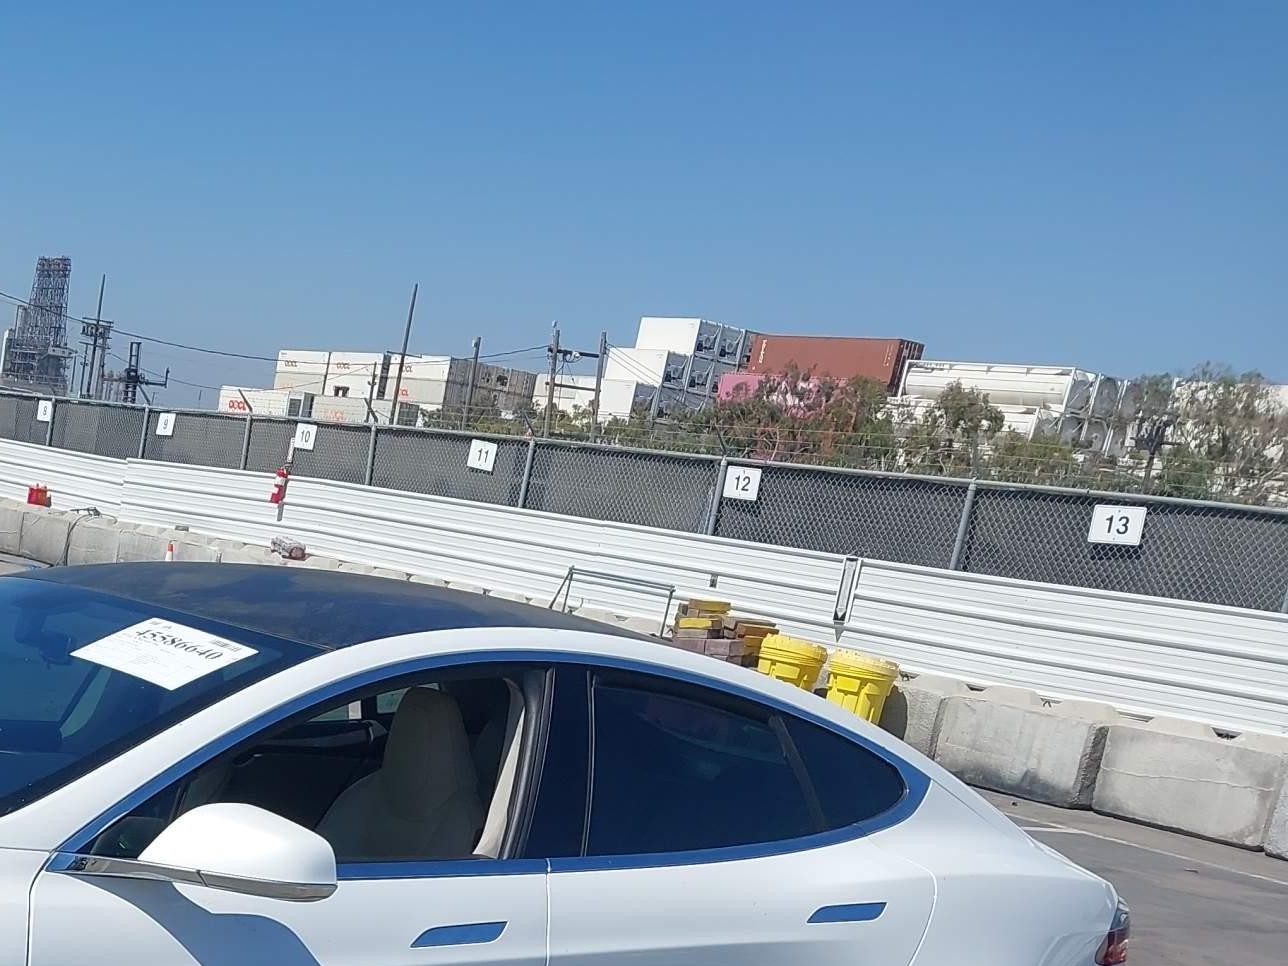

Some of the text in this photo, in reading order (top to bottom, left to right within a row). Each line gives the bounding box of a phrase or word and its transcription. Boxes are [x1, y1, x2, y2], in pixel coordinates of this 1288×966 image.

[42, 405, 48, 416] 8
[162, 418, 169, 430] 9
[300, 429, 311, 443] 10
[477, 447, 489, 463] 11
[735, 474, 751, 491] 12
[1105, 514, 1130, 535] 13
[135, 628, 224, 660] 45586640
